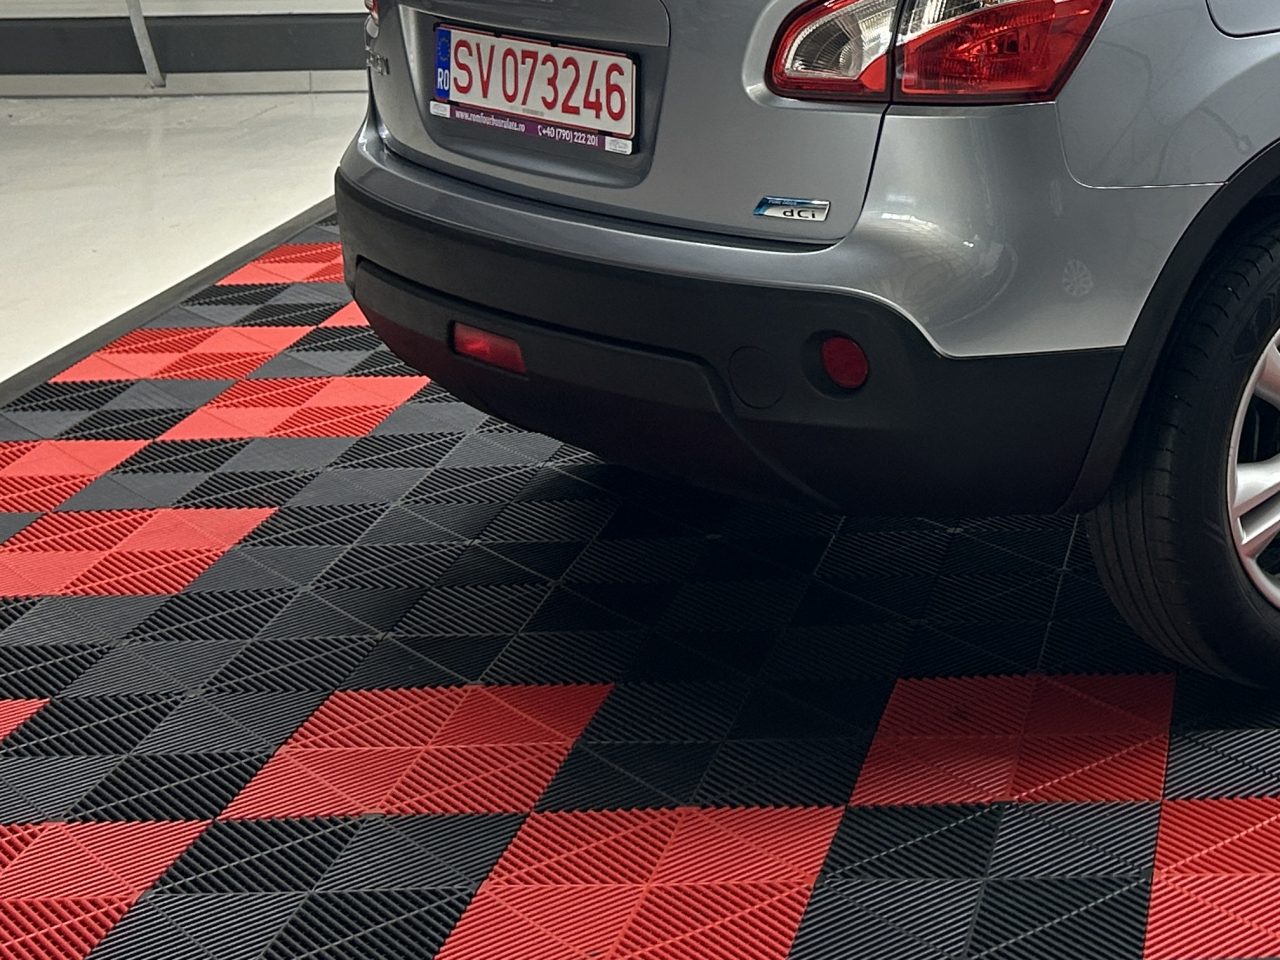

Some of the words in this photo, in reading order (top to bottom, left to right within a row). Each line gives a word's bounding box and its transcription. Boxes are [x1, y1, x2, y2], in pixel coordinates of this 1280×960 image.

[437, 68, 449, 90] RO
[573, 132, 586, 144] 222
[783, 208, 816, 219] dCi
